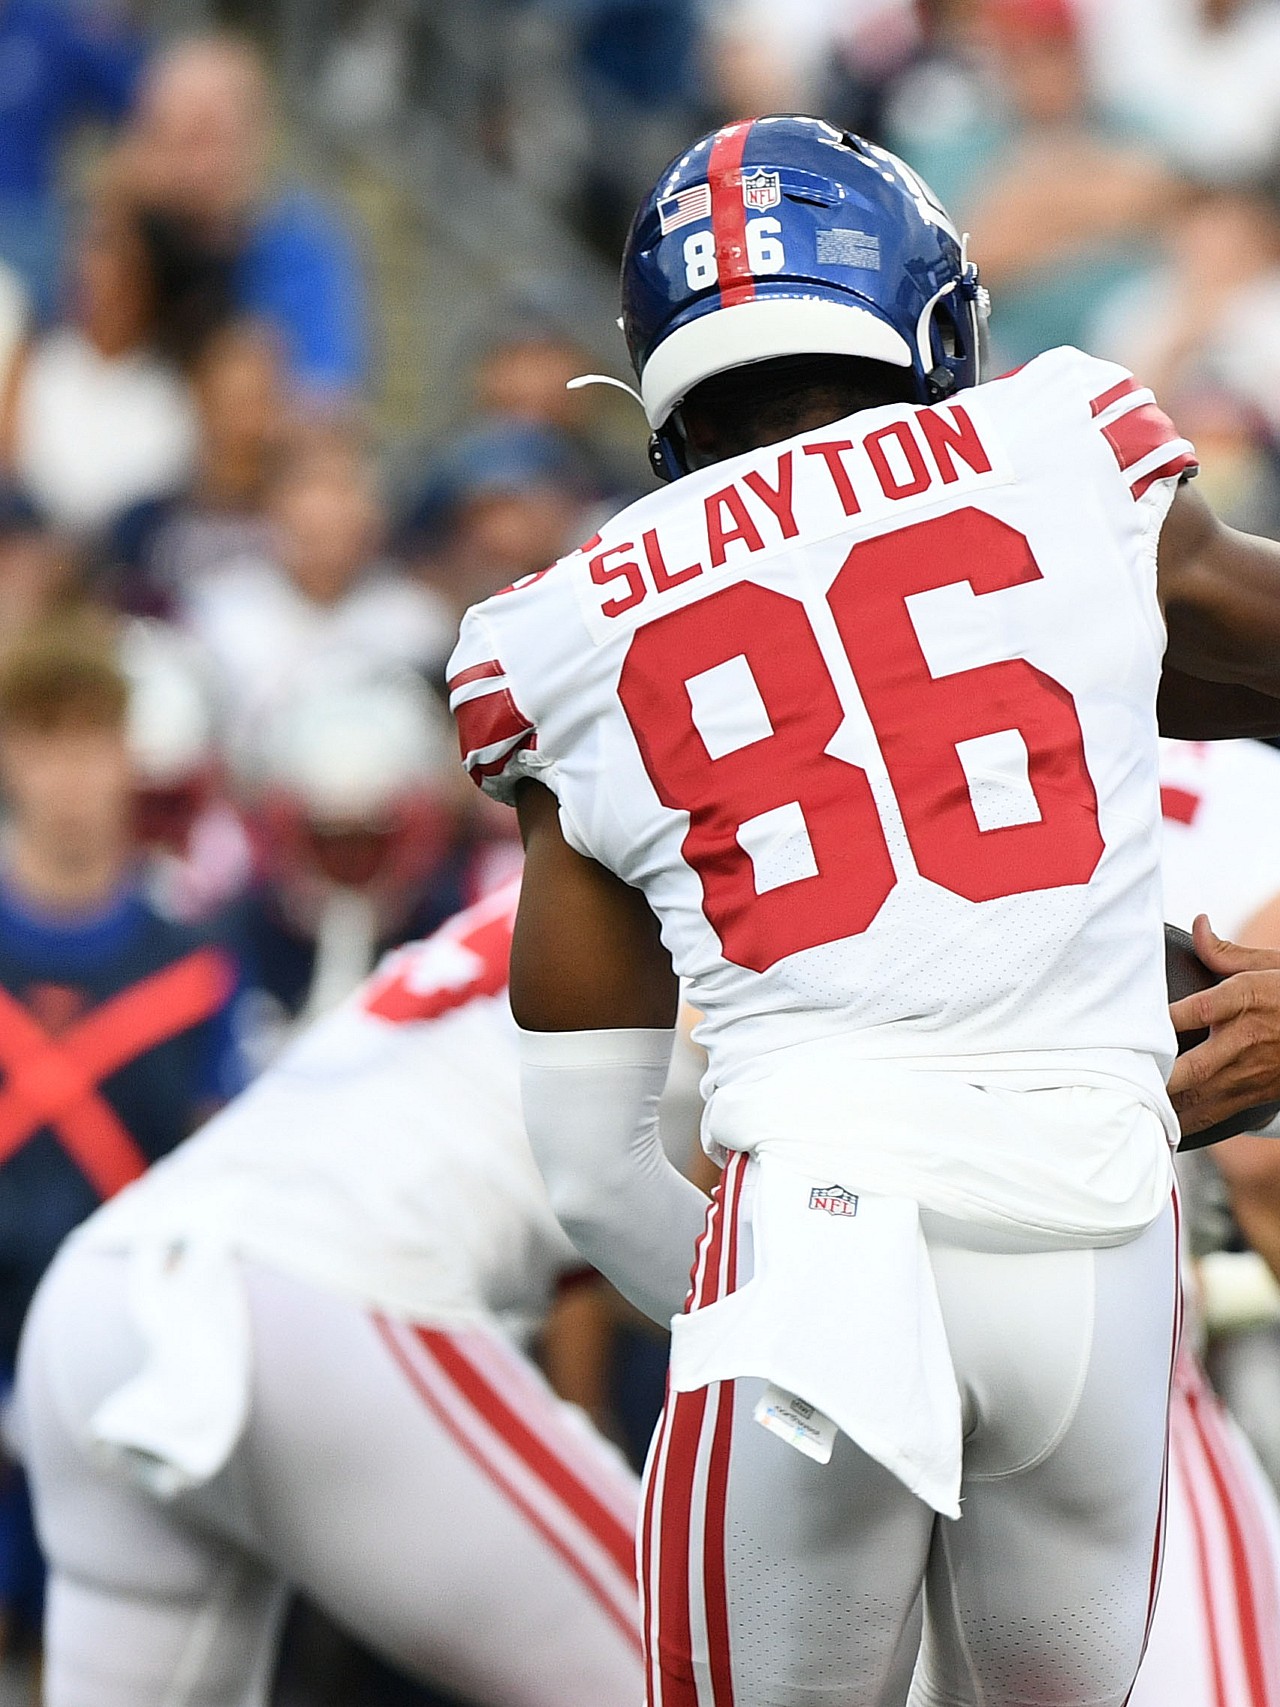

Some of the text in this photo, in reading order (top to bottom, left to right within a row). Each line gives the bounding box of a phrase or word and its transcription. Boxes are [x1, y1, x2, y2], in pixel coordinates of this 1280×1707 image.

[749, 189, 776, 206] NFL
[683, 216, 786, 292] 86
[589, 405, 992, 618] SLAYTON
[617, 506, 1106, 974] 86
[814, 1197, 853, 1215] NFL
